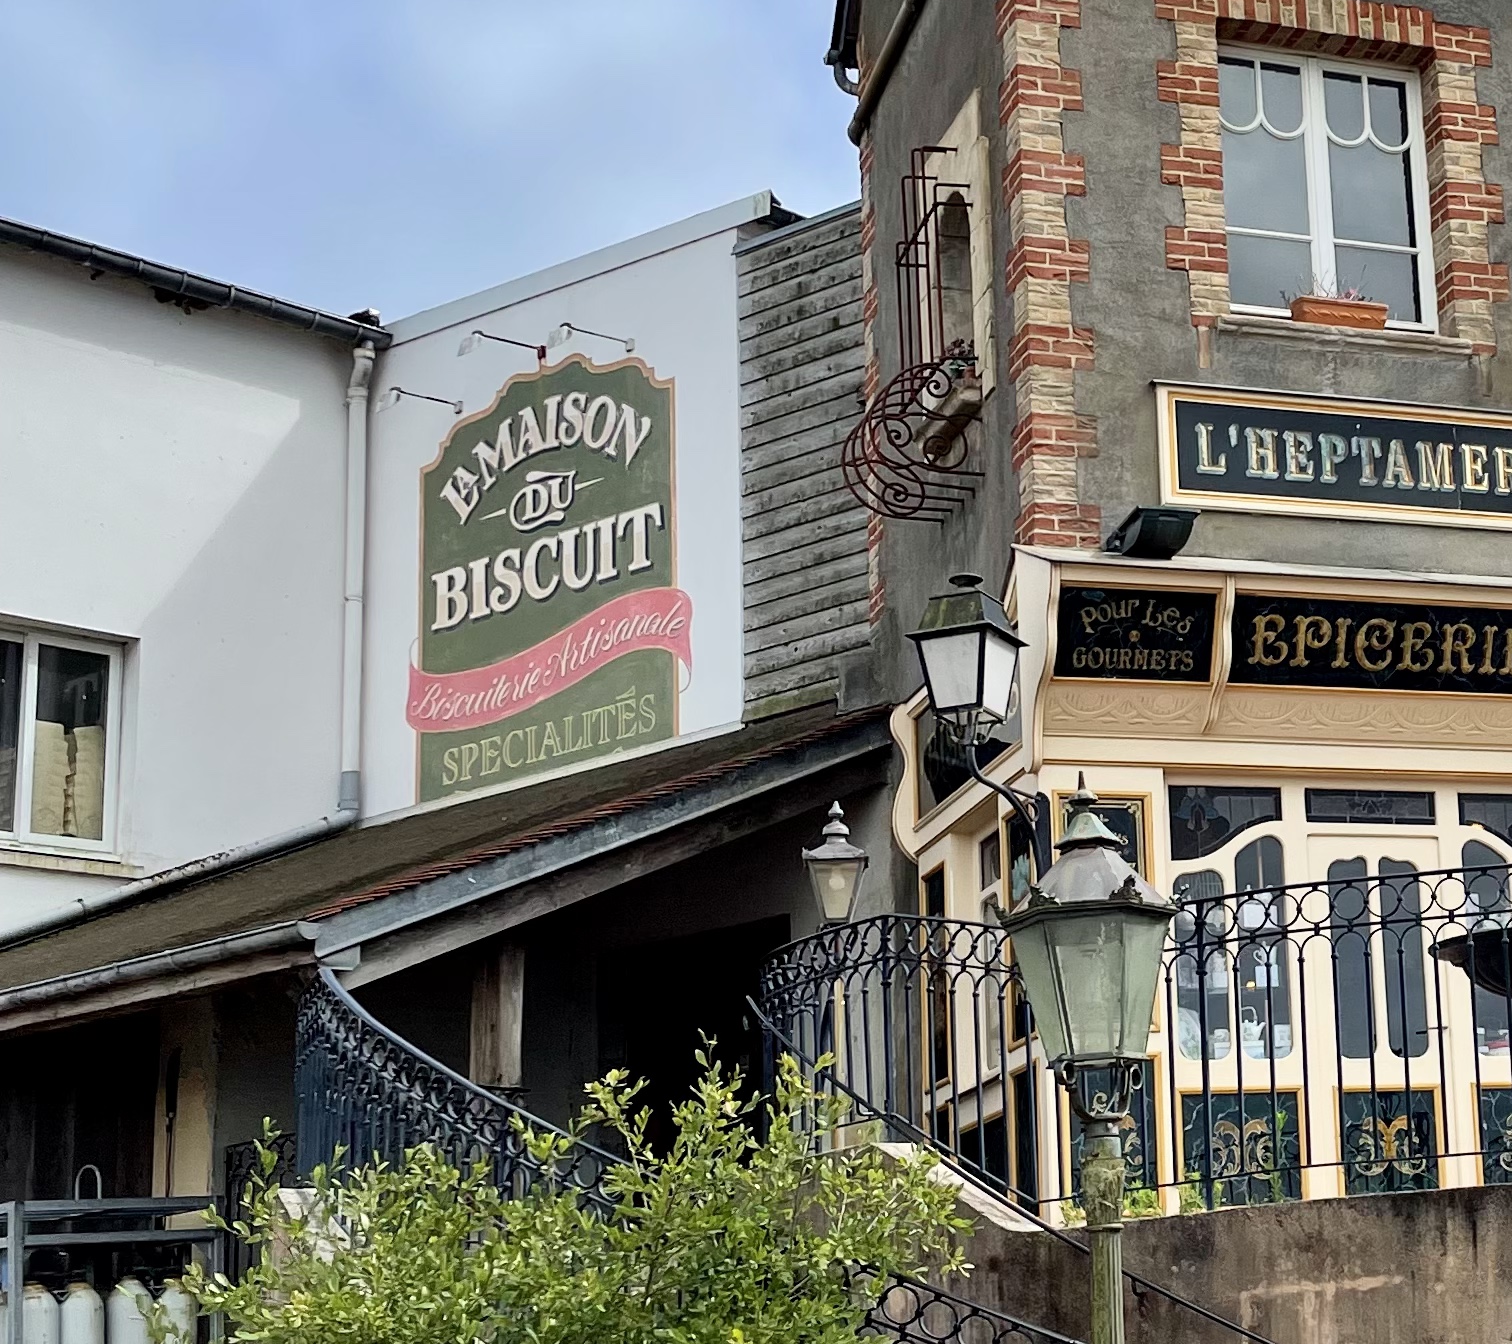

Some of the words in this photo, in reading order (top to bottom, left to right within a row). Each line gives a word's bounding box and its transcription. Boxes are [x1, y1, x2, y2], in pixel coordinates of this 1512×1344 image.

[472, 391, 652, 471] MAISON
[510, 470, 576, 531] DU
[431, 503, 665, 633] BISCUIT
[411, 664, 541, 721] Biscuiterie
[542, 599, 686, 687] Artisanale
[1072, 646, 1194, 672] GOURMETS
